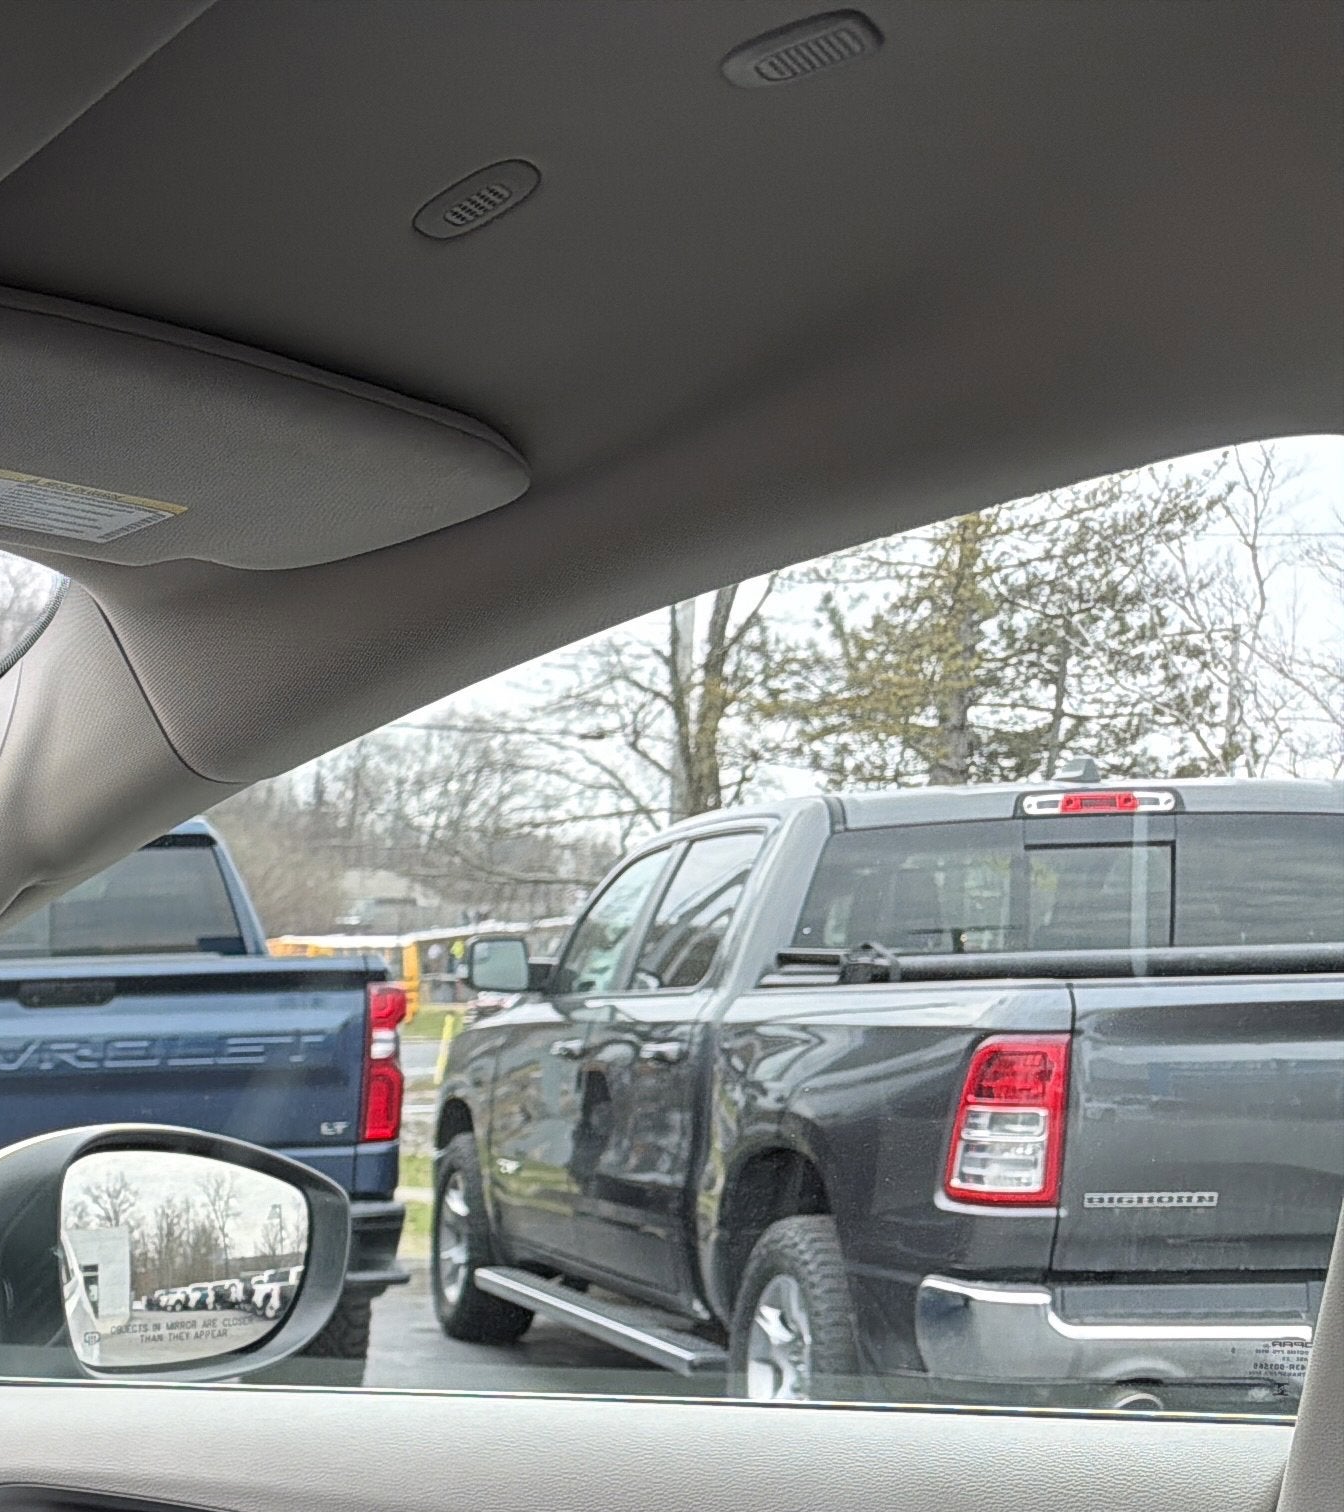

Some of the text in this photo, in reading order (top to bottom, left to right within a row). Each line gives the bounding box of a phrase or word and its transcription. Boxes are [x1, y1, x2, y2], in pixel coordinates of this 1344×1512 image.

[110, 1323, 149, 1336] OBJECTS
[151, 1322, 161, 1333] IN
[165, 1319, 197, 1331] MIRROR
[201, 1318, 219, 1329] ARE
[140, 1327, 228, 1344] THAN THEY APPEAR
